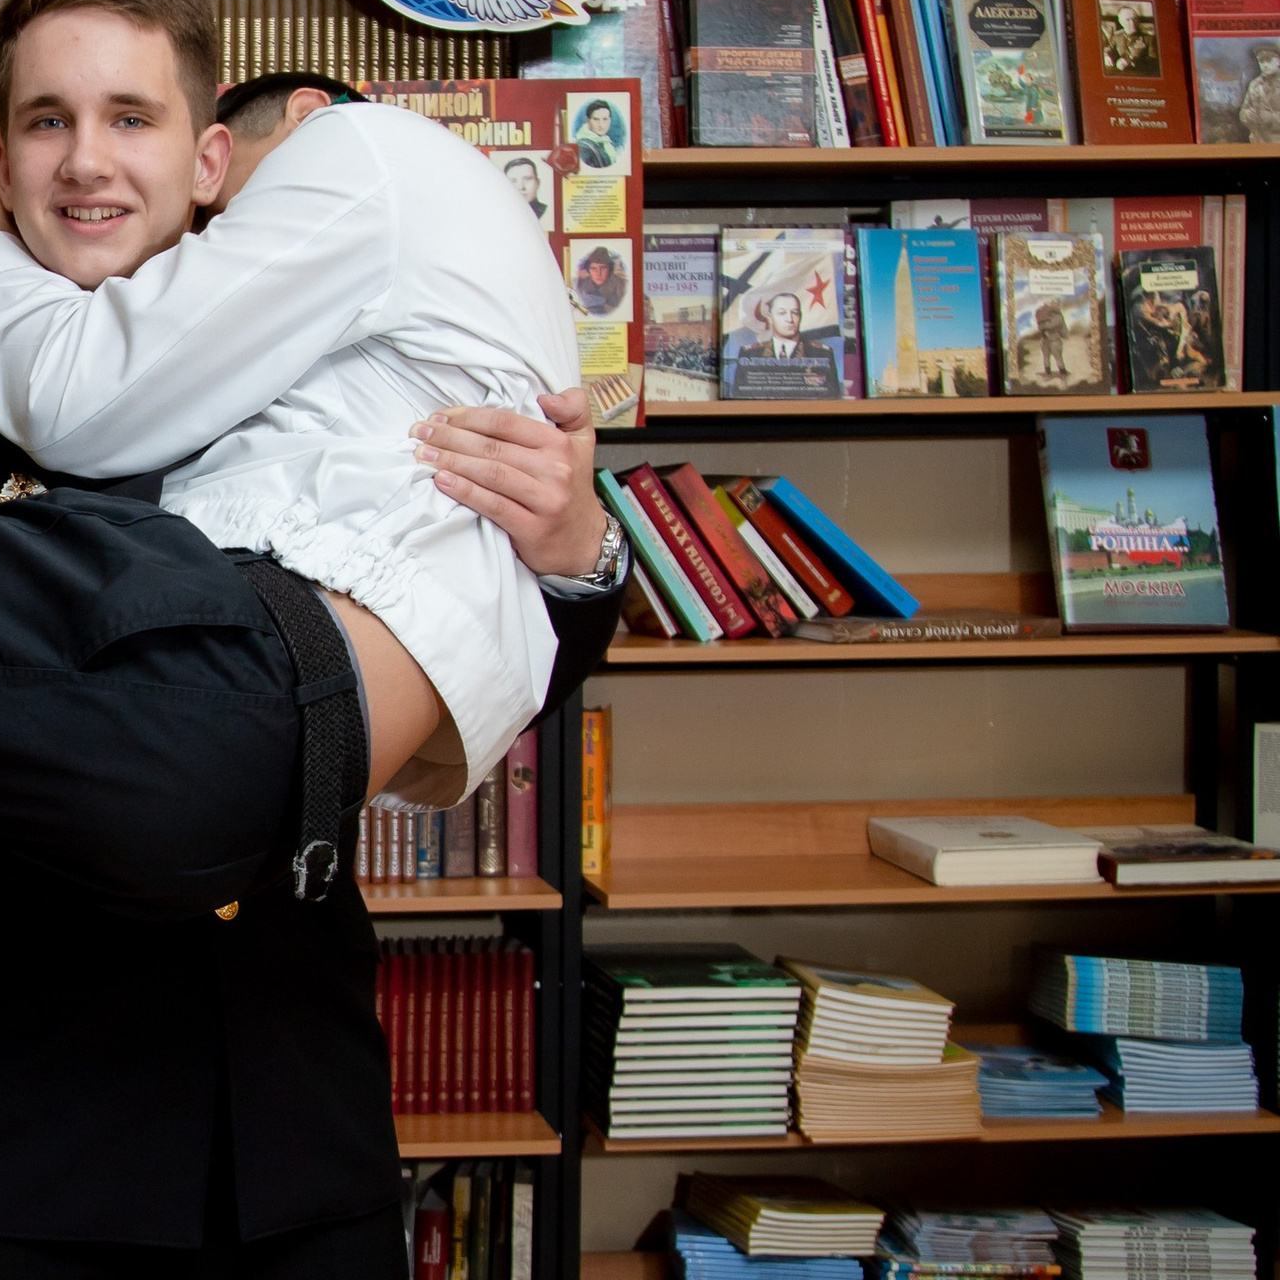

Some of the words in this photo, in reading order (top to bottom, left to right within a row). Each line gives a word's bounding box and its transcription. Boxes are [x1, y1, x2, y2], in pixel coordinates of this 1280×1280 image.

[975, 6, 1038, 18] АЛЕКСЕЕВ
[717, 58, 802, 67] УЧАСТНИКОВ
[381, 88, 484, 116] ВЕЛИКОЙ
[1107, 98, 1166, 108] СТАНОВЛЕНИЕ
[1130, 118, 1168, 130] Жукова
[448, 118, 532, 146] ВОЙНЫ
[1120, 212, 1151, 220] ГЕРОИ
[1152, 210, 1192, 220] РОДИНЫ
[1121, 234, 1148, 243] УЛИЦ
[1149, 232, 1190, 242] МОСКВЫ
[645, 262, 687, 270] ПОДВИГ
[667, 272, 714, 281] МОСКВЫ
[651, 492, 672, 523] ВЕКА
[1090, 534, 1190, 552] РОДИНА...
[686, 548, 726, 605] СОЛДАТЫ
[1103, 580, 1186, 598] МОСКВА
[881, 626, 922, 638] СЛАВЫ
[924, 626, 971, 638] РАТНОЙ
[974, 624, 1020, 638] ДОРОГИ
